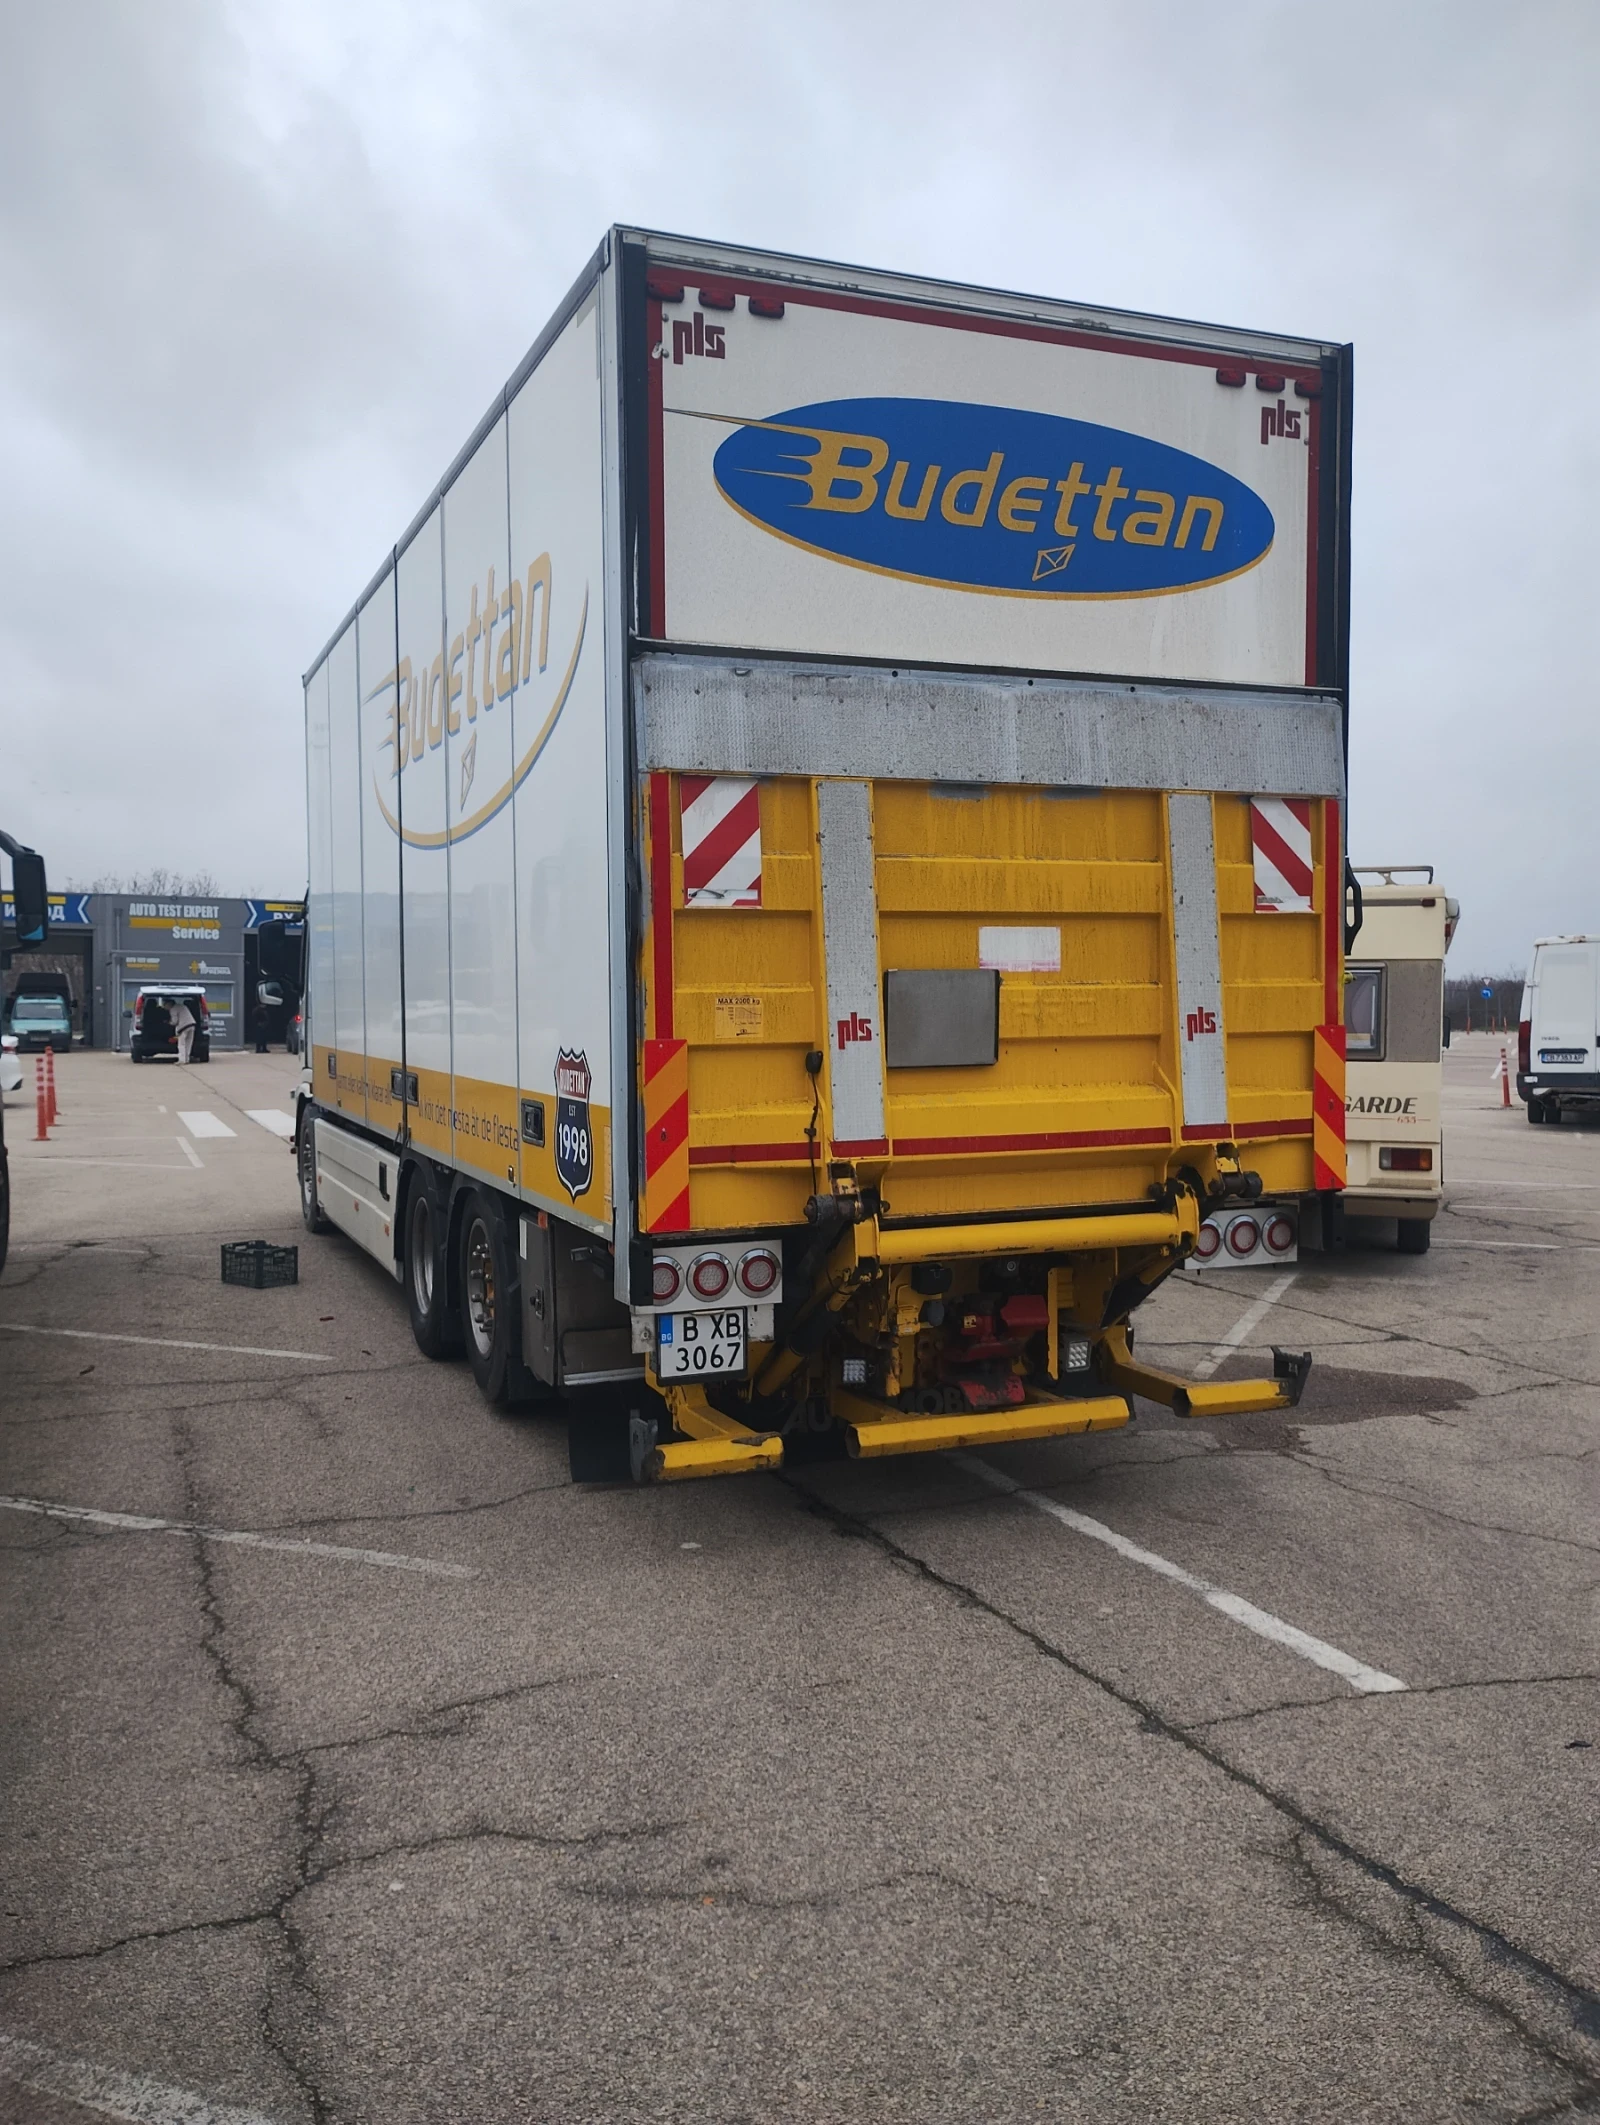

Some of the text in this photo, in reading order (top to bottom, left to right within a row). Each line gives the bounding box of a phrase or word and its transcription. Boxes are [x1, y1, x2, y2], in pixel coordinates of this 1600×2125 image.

[673, 311, 725, 365] pls
[1261, 399, 1301, 445] pls
[806, 431, 1225, 551] Budettan
[129, 903, 220, 918] AUTO TEST EXPERT
[172, 926, 220, 940] Service
[837, 1012, 872, 1050] pls
[1187, 1006, 1216, 1041] pls
[559, 1123, 588, 1166] 1998
[662, 1333, 672, 1341] BG
[683, 1313, 741, 1342] B XB
[676, 1342, 740, 1372] 3067
